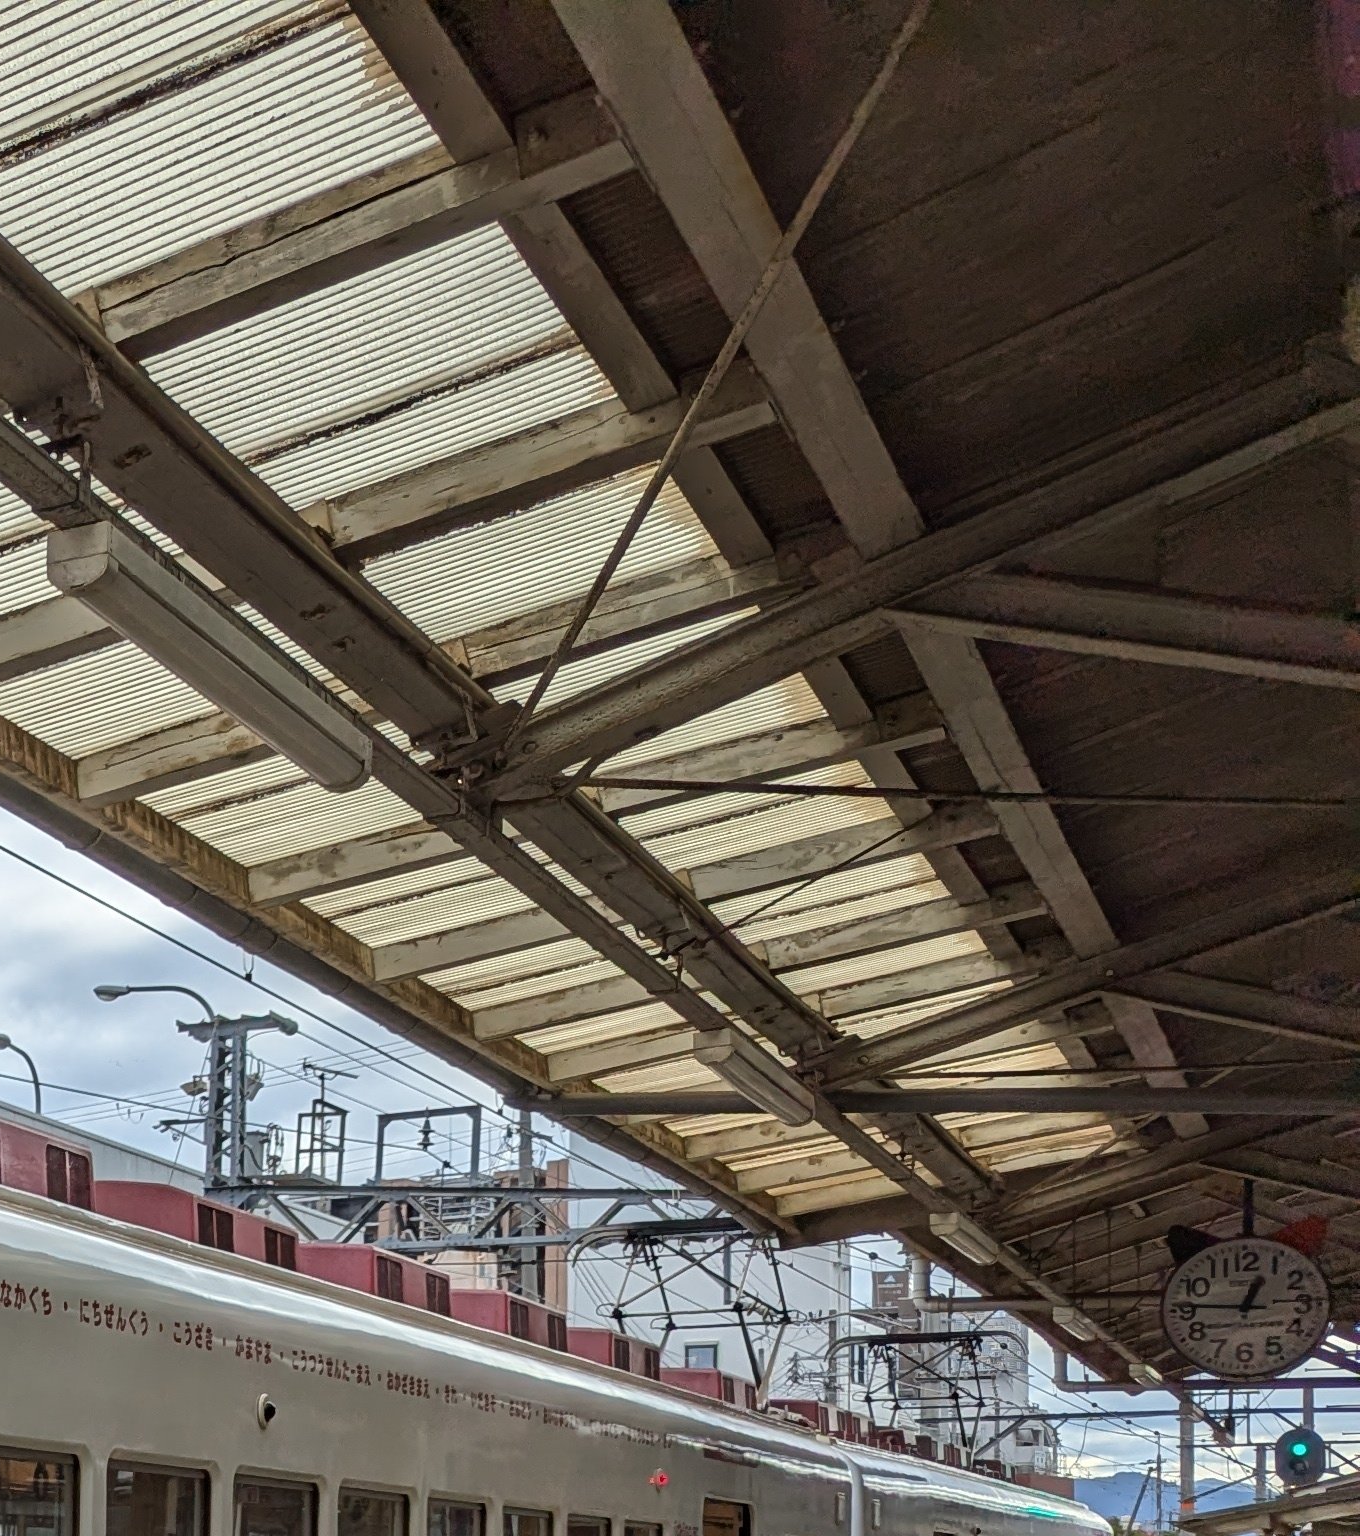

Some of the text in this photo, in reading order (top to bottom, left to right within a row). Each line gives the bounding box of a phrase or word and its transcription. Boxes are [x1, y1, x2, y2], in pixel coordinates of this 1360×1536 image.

[1208, 1256, 1229, 1278] 11
[1235, 1252, 1259, 1272] 12
[1271, 1255, 1278, 1275] 1
[1180, 1276, 1211, 1298] 10
[1288, 1270, 1304, 1291] 2
[1188, 1321, 1207, 1342] 8
[1286, 1318, 1304, 1336] 4
[1210, 1338, 1228, 1358] 7
[1235, 1342, 1254, 1363] 6
[1265, 1335, 1283, 1355] 5
